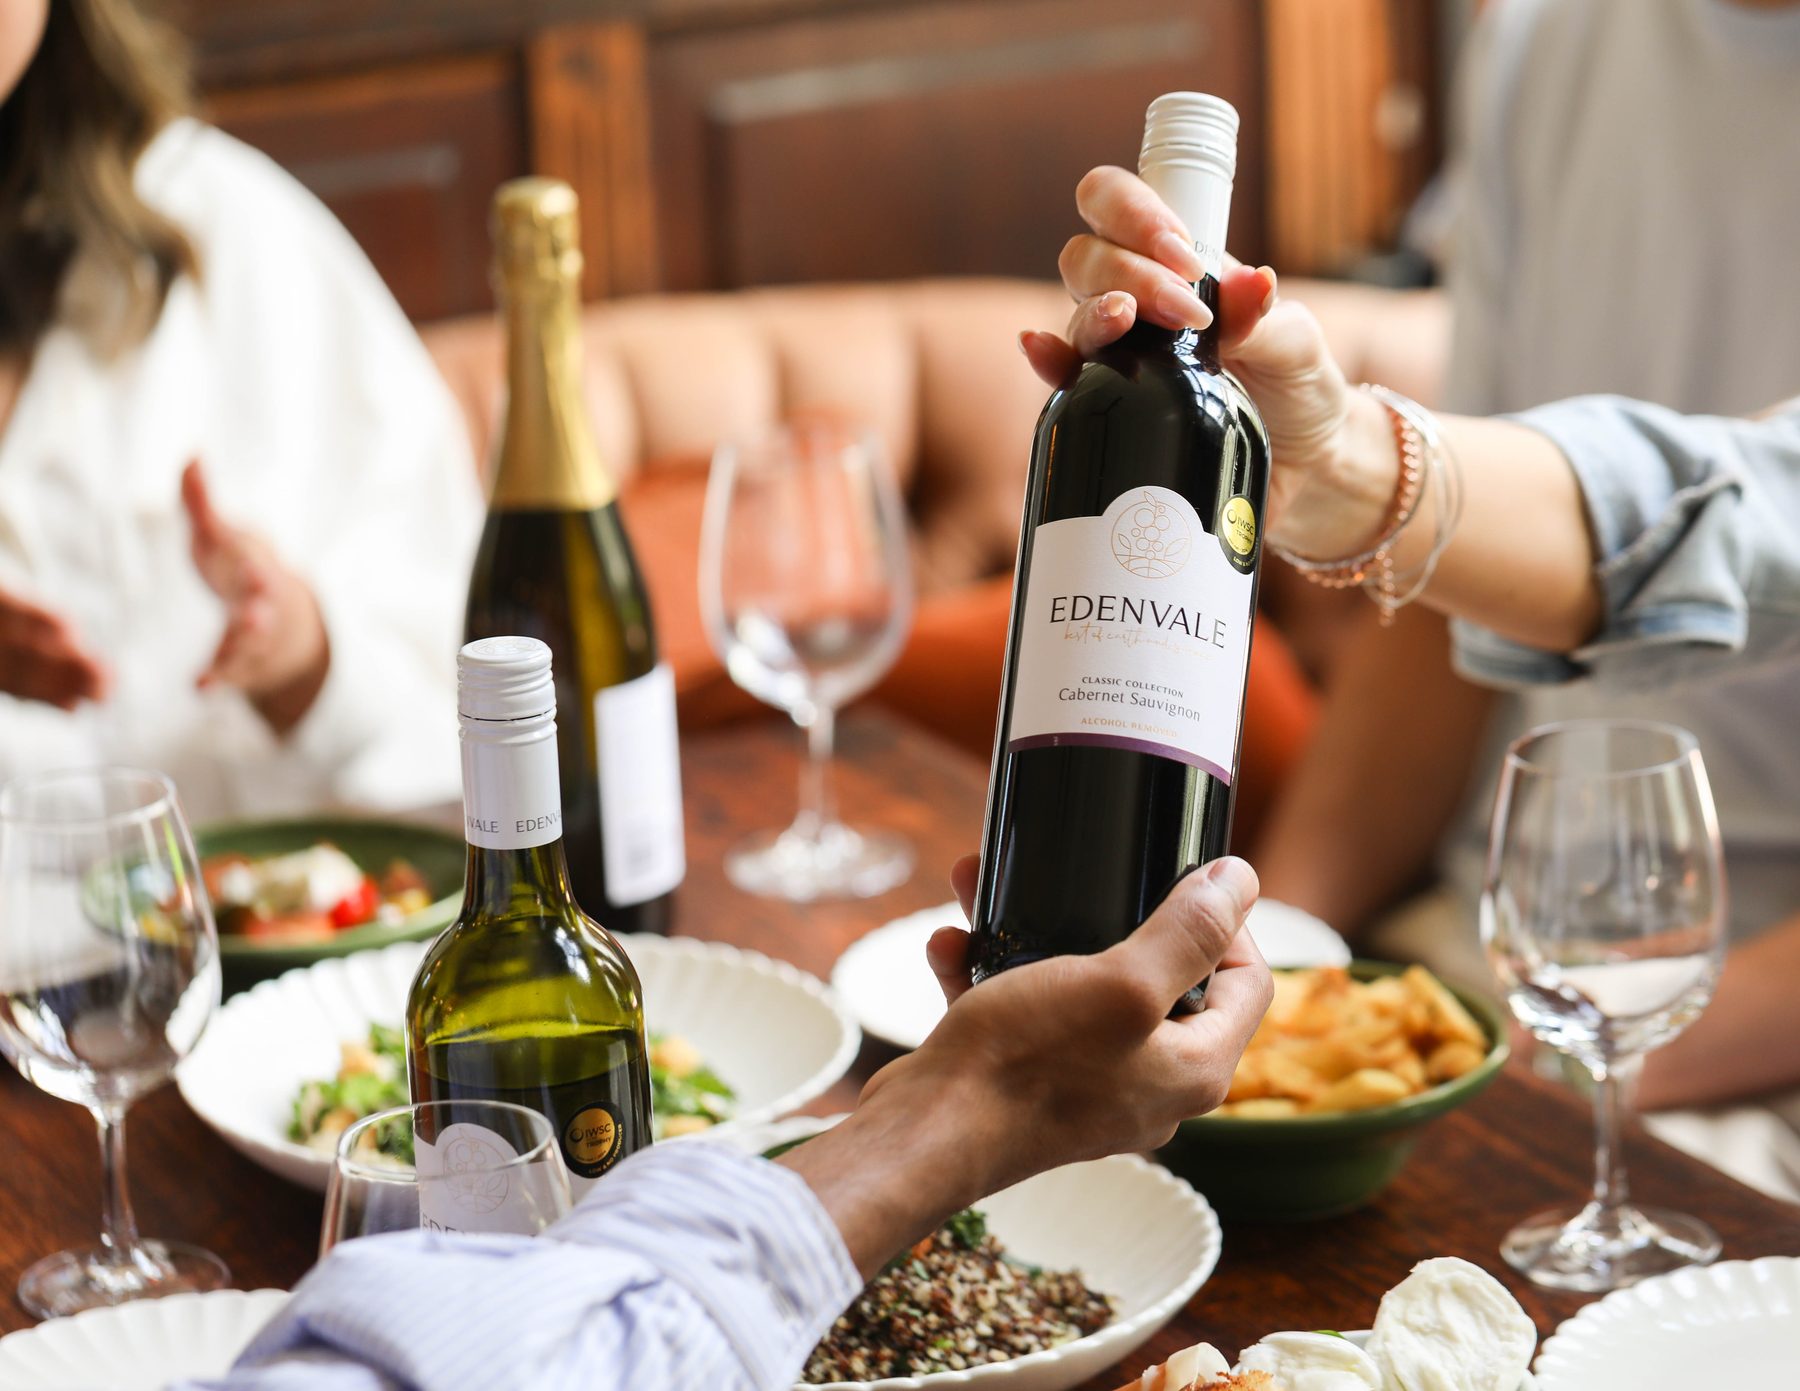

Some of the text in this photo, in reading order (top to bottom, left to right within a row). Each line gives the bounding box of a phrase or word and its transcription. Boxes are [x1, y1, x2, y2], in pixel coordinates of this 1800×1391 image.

[1237, 516, 1254, 535] IWSC
[1049, 594, 1227, 648] EDENVALE
[1082, 676, 1184, 698] CLASSIC COLLECTION
[1058, 687, 1201, 722] Cabernet Sauvignon
[1081, 717, 1128, 728] ALCOHOL
[585, 1123, 611, 1138] IWSC
